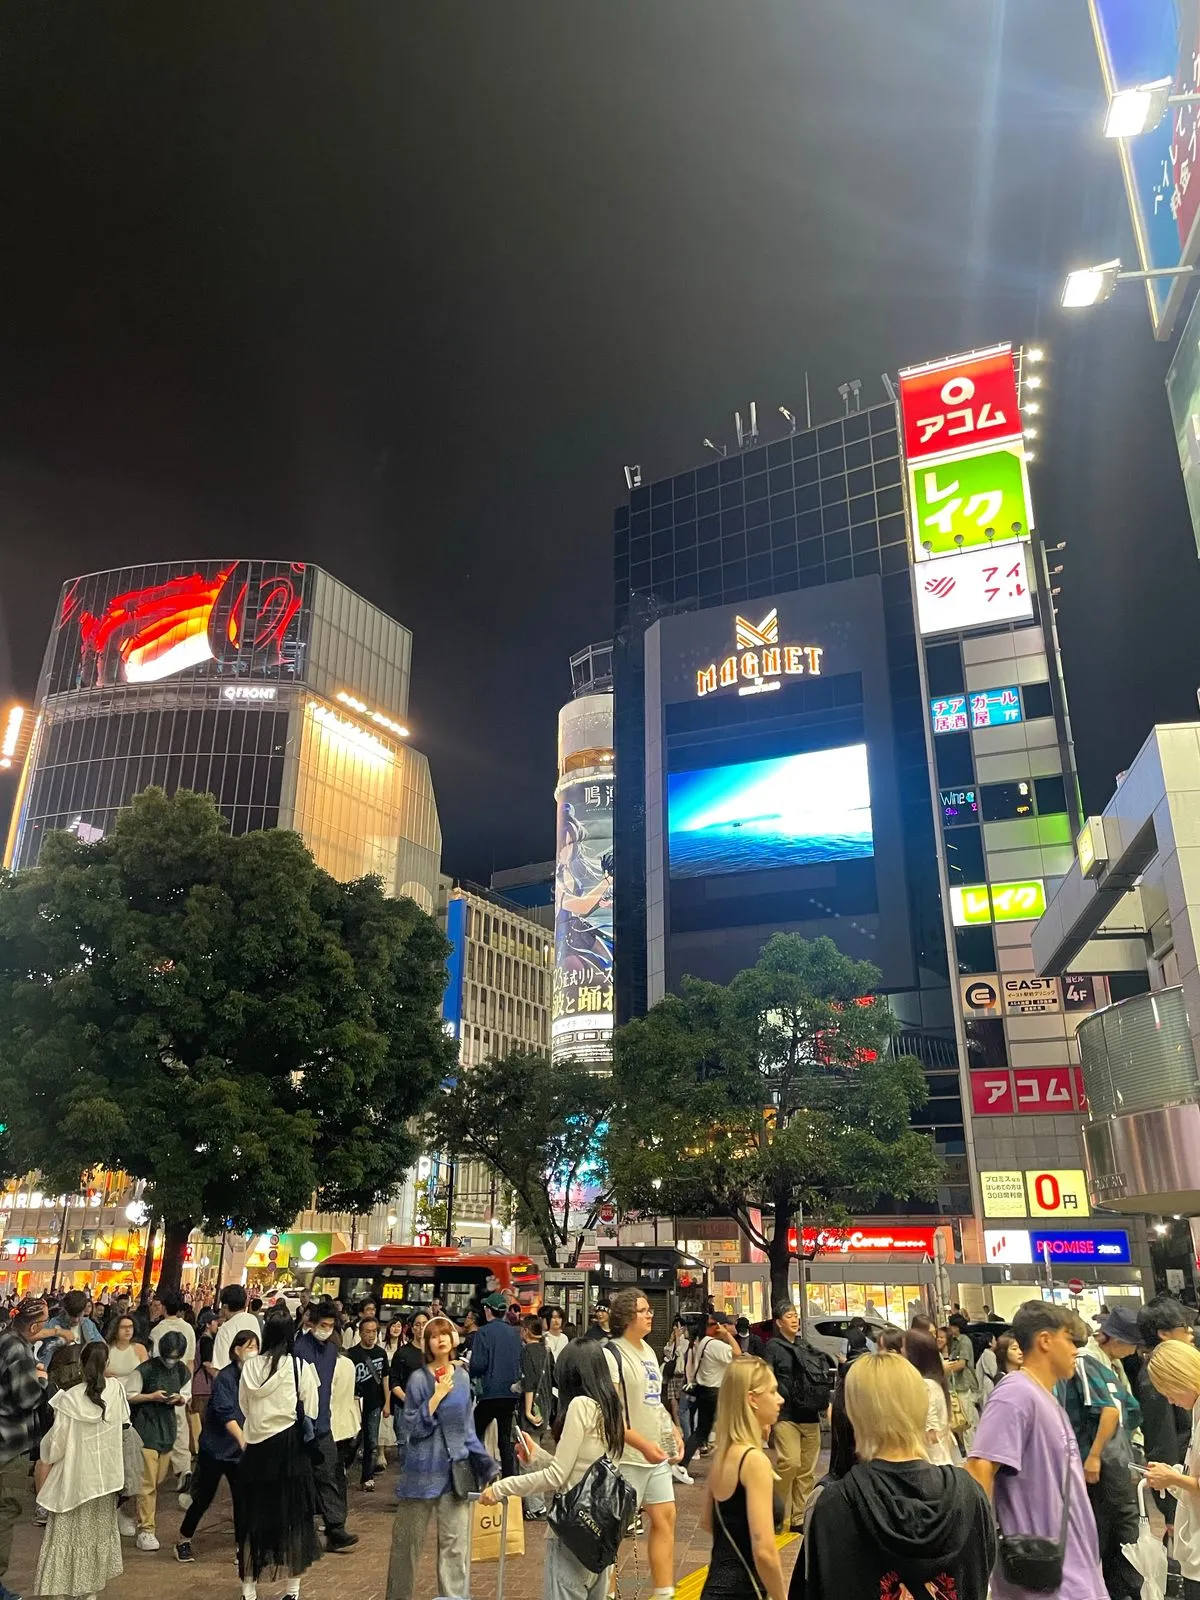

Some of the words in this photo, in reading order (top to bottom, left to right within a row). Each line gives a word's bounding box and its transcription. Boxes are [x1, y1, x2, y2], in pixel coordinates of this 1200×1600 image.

[916, 402, 1007, 444] アコム
[696, 646, 823, 697] MAGNET
[935, 710, 990, 732] 居酒屋
[966, 887, 1037, 915] レイク
[1005, 978, 1054, 991] EAST
[1066, 984, 1087, 1002] 4F
[984, 1078, 1071, 1105] アコム
[1036, 1239, 1095, 1254] PROMISE
[578, 1510, 601, 1537] CHANEL
